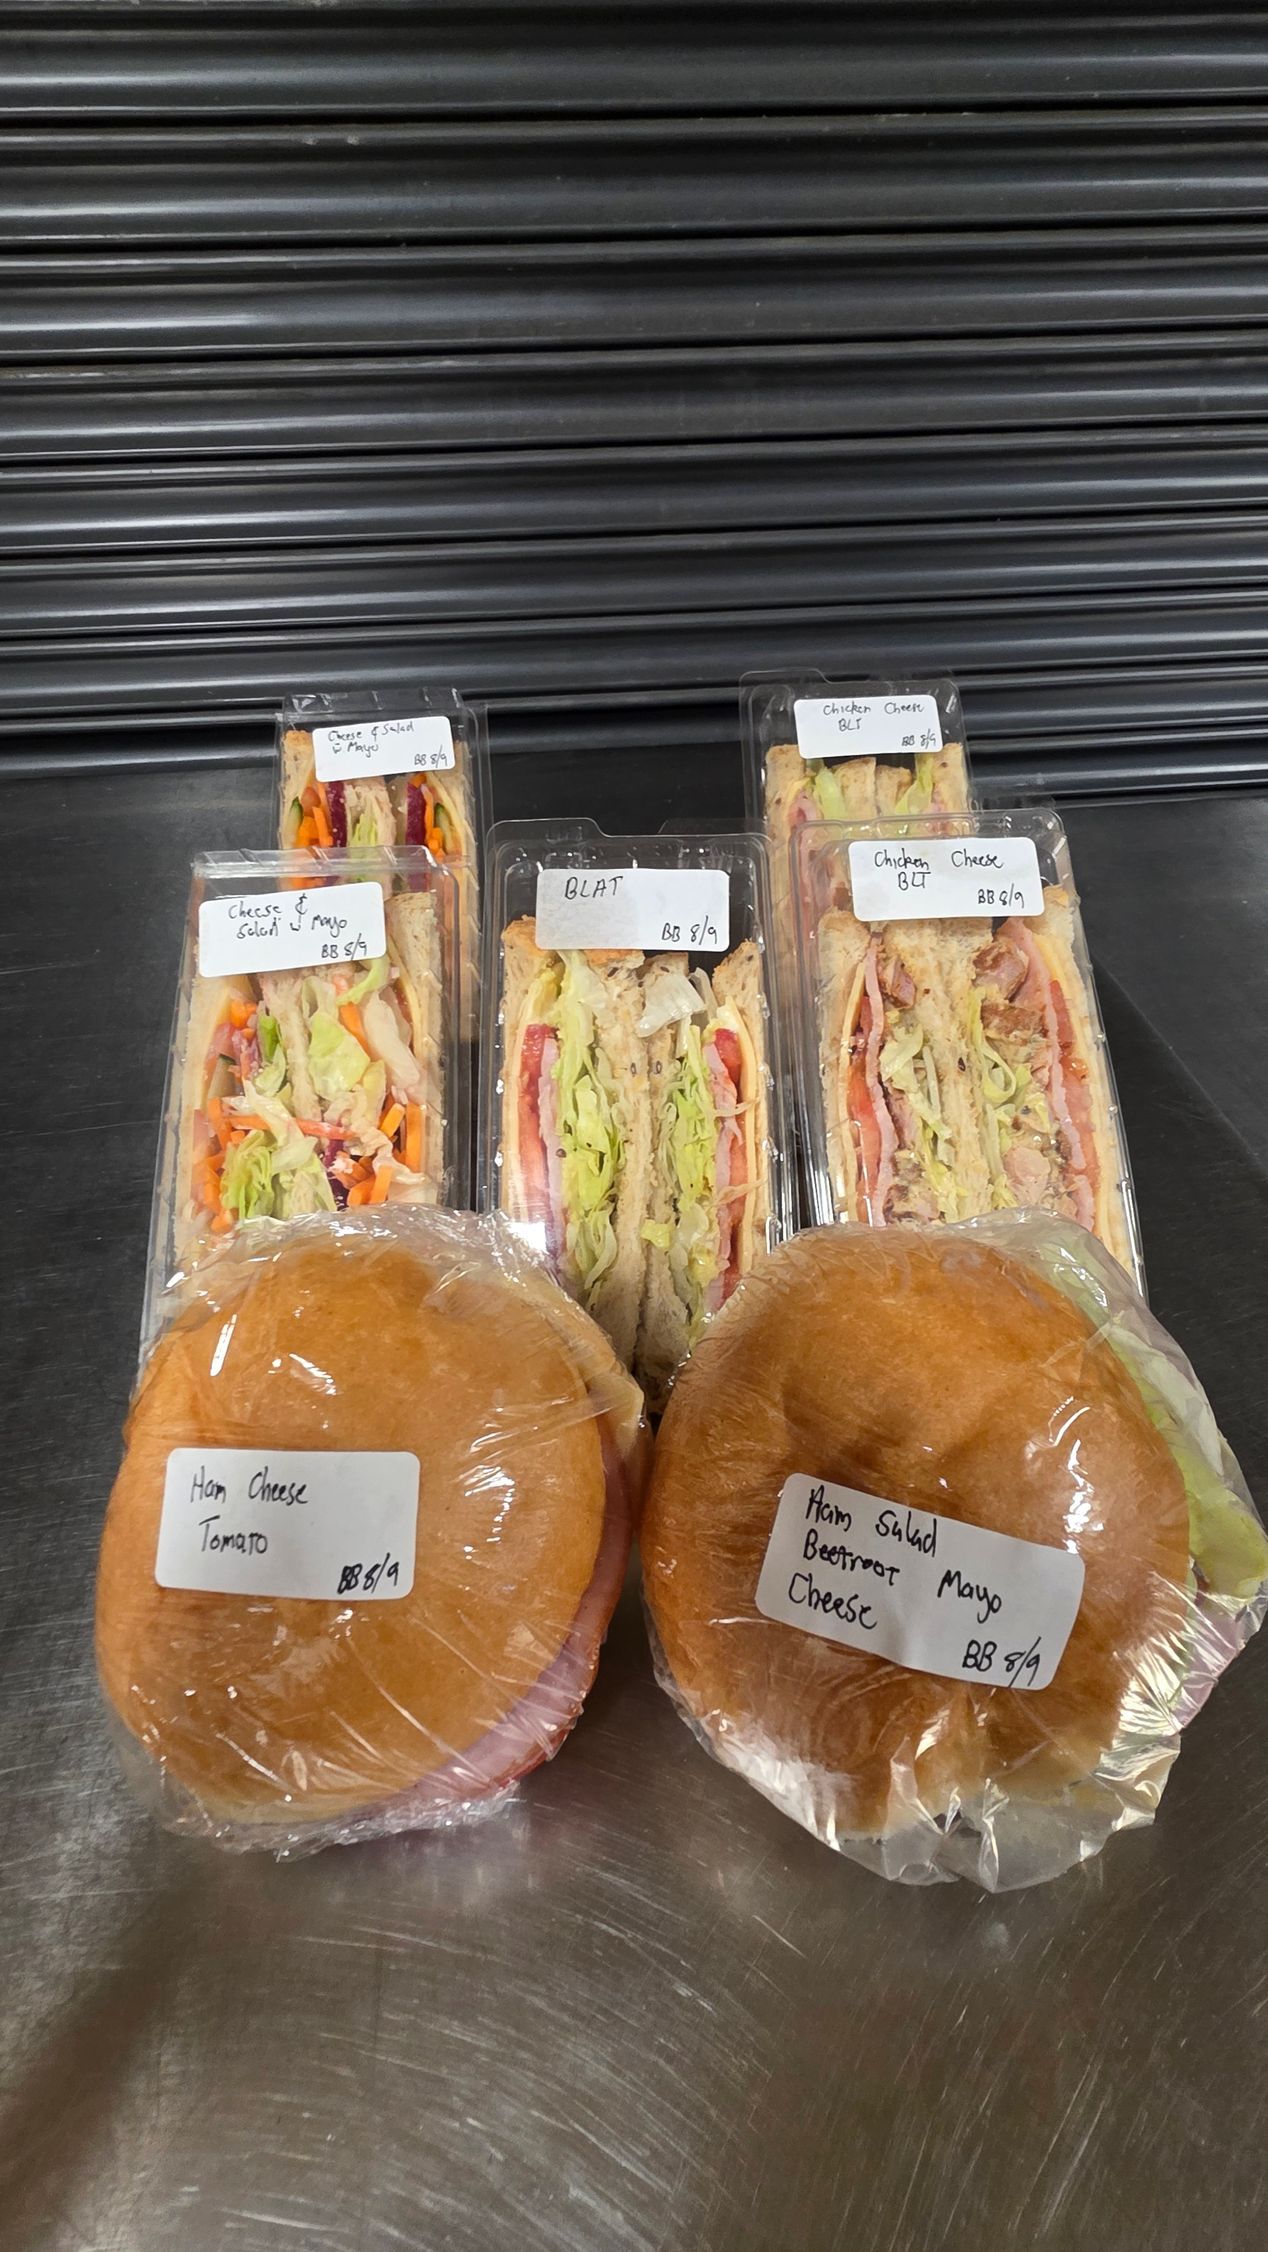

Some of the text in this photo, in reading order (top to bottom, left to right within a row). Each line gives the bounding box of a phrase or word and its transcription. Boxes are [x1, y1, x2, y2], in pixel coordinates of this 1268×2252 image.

[823, 700, 925, 716] Chicken Cheese
[381, 721, 415, 735] Salad
[838, 718, 862, 732] BLT
[347, 741, 379, 758] Mayo
[901, 728, 937, 749] BB 8/9
[414, 745, 448, 768] BB 8/9
[874, 847, 1004, 870] Chicken Cheese
[564, 876, 623, 900] BLAT
[898, 871, 931, 891] BLT
[978, 883, 1025, 909] BB 8/9
[228, 900, 281, 919] Cheese
[236, 917, 280, 939] Salad
[311, 914, 347, 938] Mayo
[661, 915, 717, 945] BB 8/9
[321, 933, 367, 961] BB 8/9
[190, 1465, 309, 1506] Ham Cheese
[805, 1484, 937, 1557] Ham Salad
[199, 1515, 268, 1555] Tomato
[337, 1553, 400, 1595] BB 8/9
[803, 1528, 1002, 1624] Beetroot Mayo
[788, 1572, 878, 1630] Cheese
[962, 1636, 1042, 1687] BB 8/9
